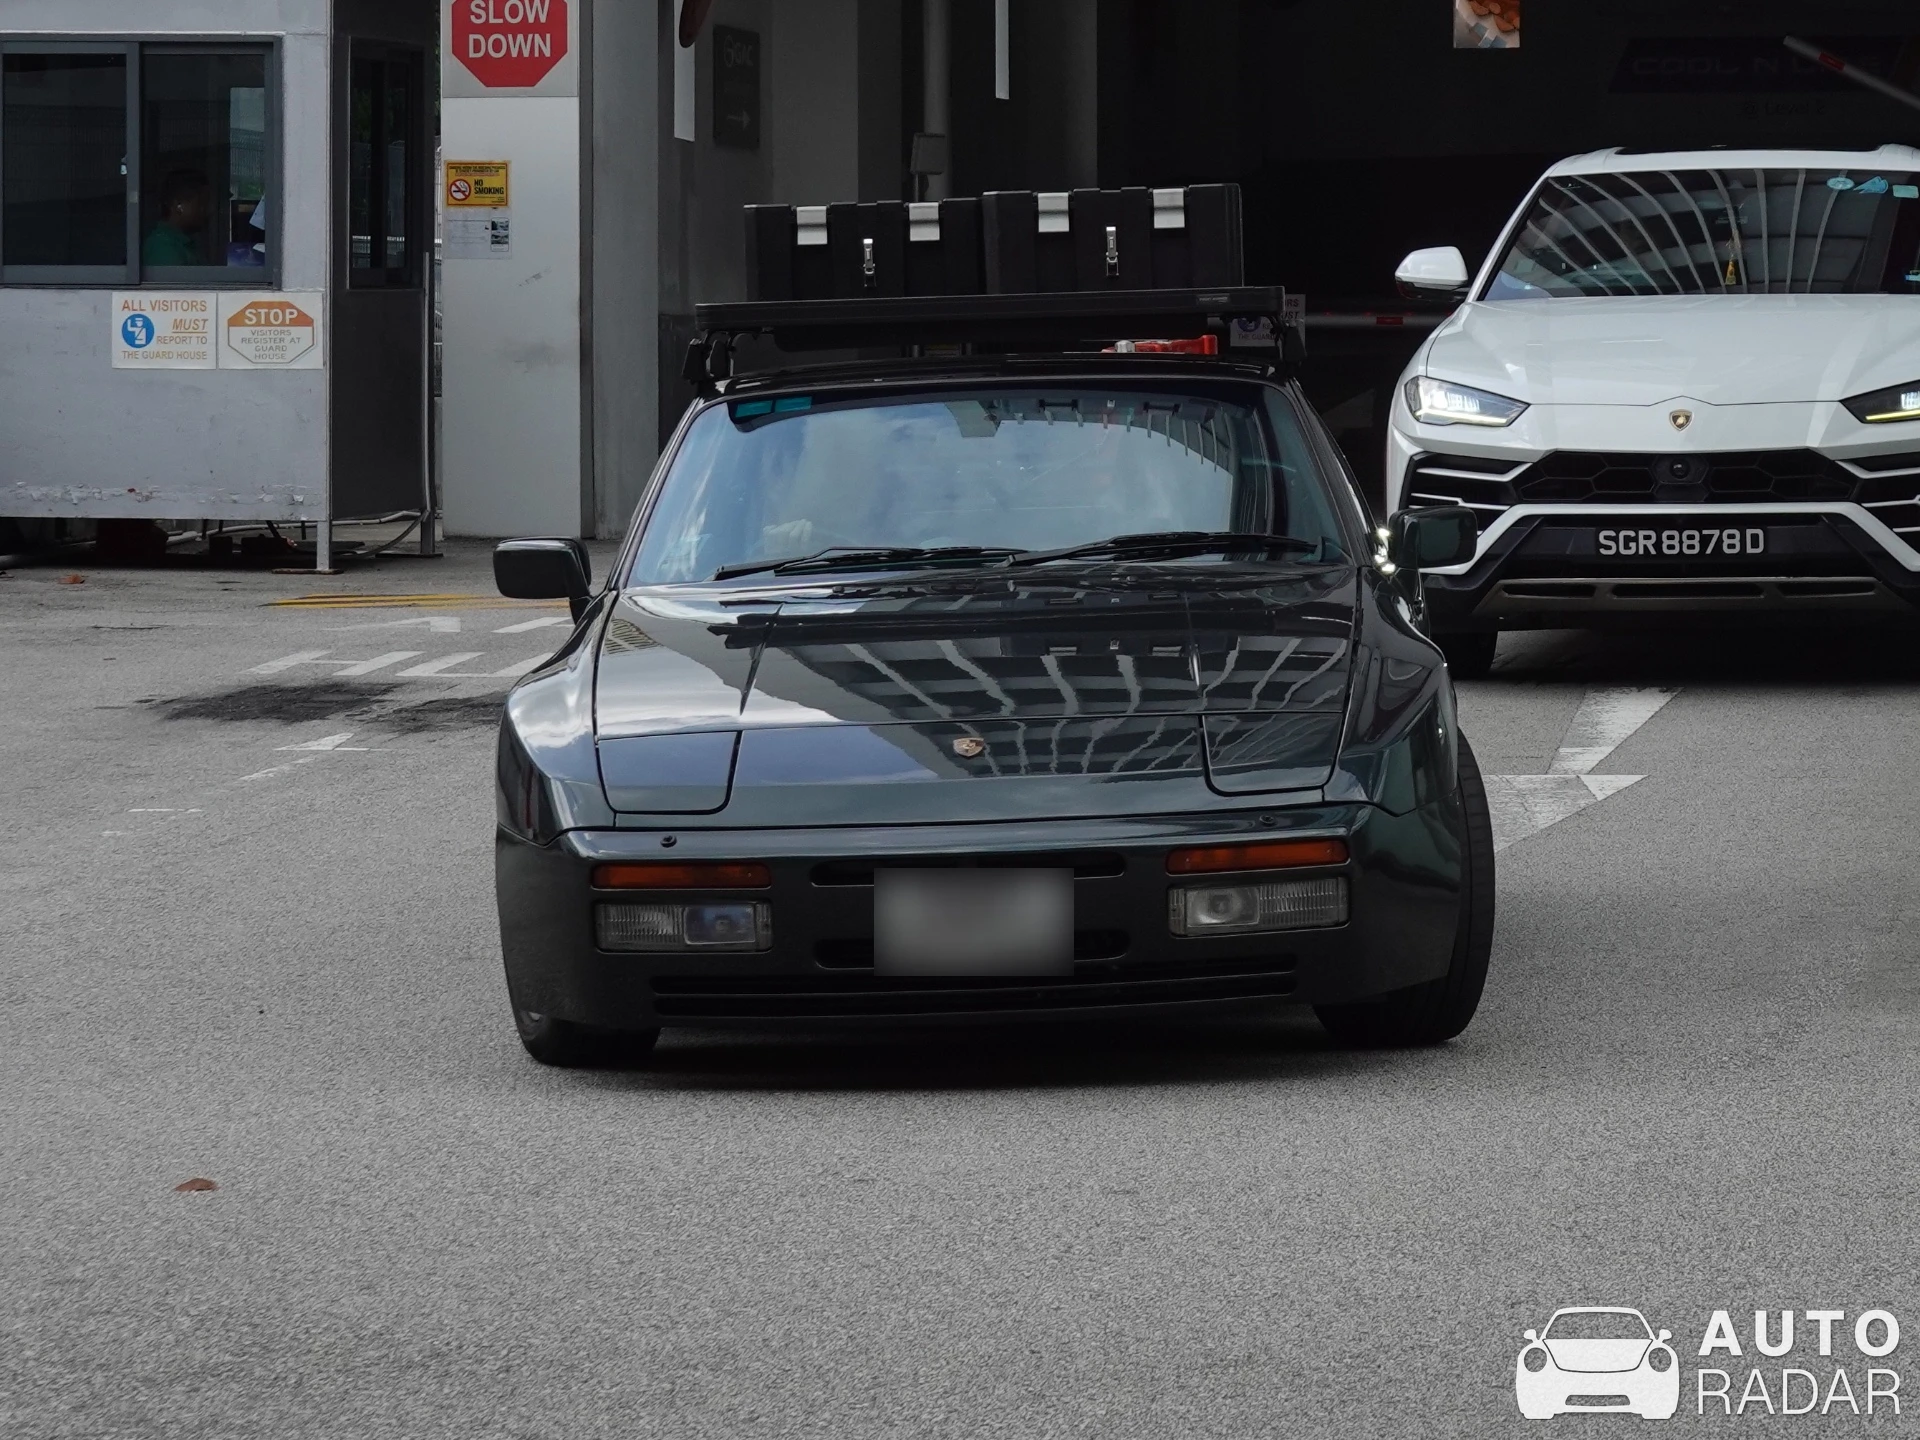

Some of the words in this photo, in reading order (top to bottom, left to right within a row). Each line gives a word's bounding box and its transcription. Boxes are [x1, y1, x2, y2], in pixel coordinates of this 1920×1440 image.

[470, 0, 550, 24] SLOW
[469, 34, 551, 58] DOWN
[474, 187, 505, 195] SMOKING
[121, 300, 146, 312] ALL
[150, 300, 207, 312] VISITORS
[244, 308, 298, 325] STOP
[172, 318, 208, 331] MUST
[156, 335, 195, 345] REPORT
[196, 335, 208, 345] TO
[255, 344, 287, 352] GUARD
[122, 350, 139, 360] THE
[142, 350, 174, 360] GUARD
[177, 350, 207, 360] HOUSE
[254, 352, 286, 360] HOUSE
